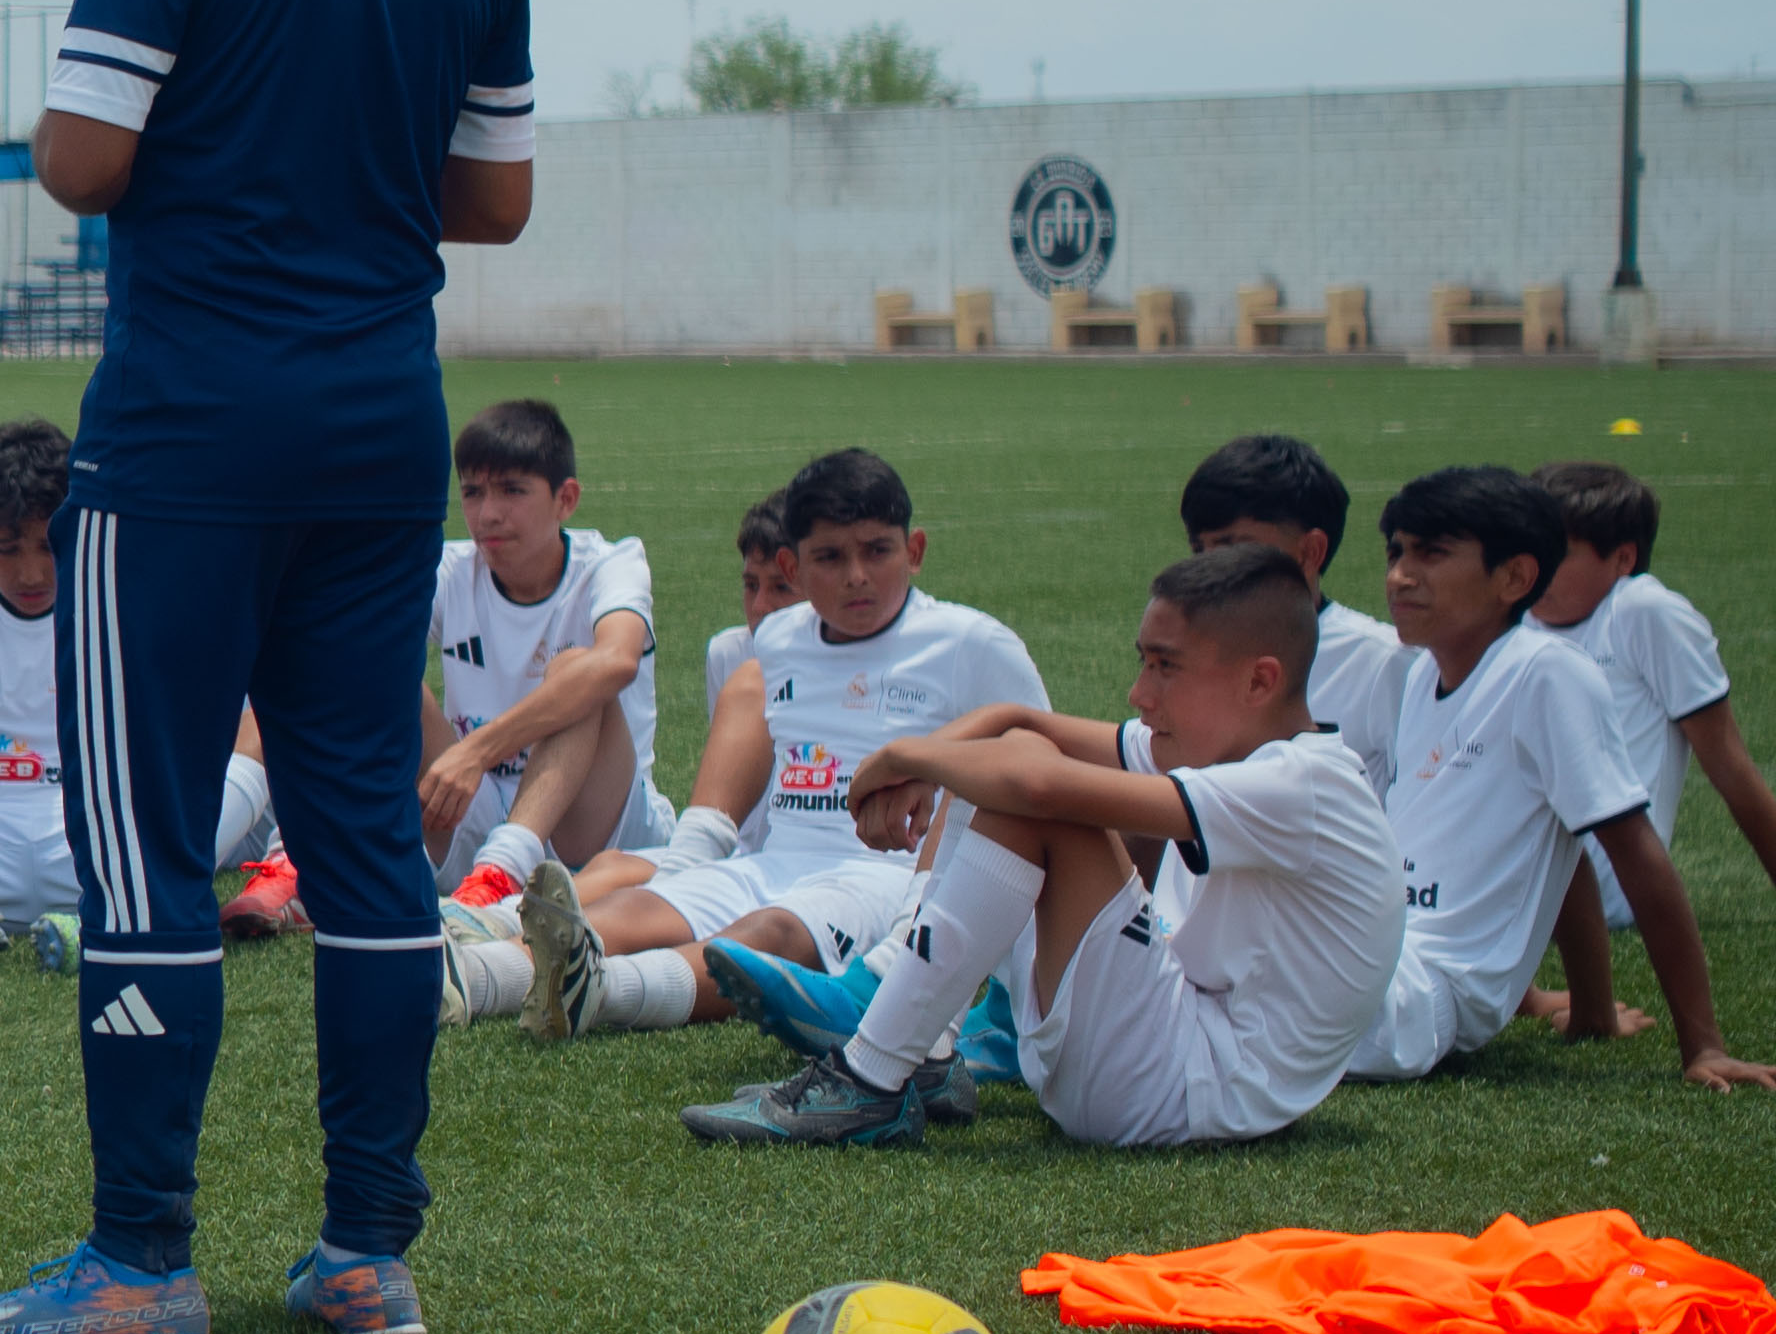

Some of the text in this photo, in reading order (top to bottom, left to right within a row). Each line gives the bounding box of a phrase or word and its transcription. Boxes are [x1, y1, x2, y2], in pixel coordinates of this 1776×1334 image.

[887, 684, 926, 704] Clinic
[771, 789, 849, 812] comuni
[1406, 882, 1439, 909] ad
